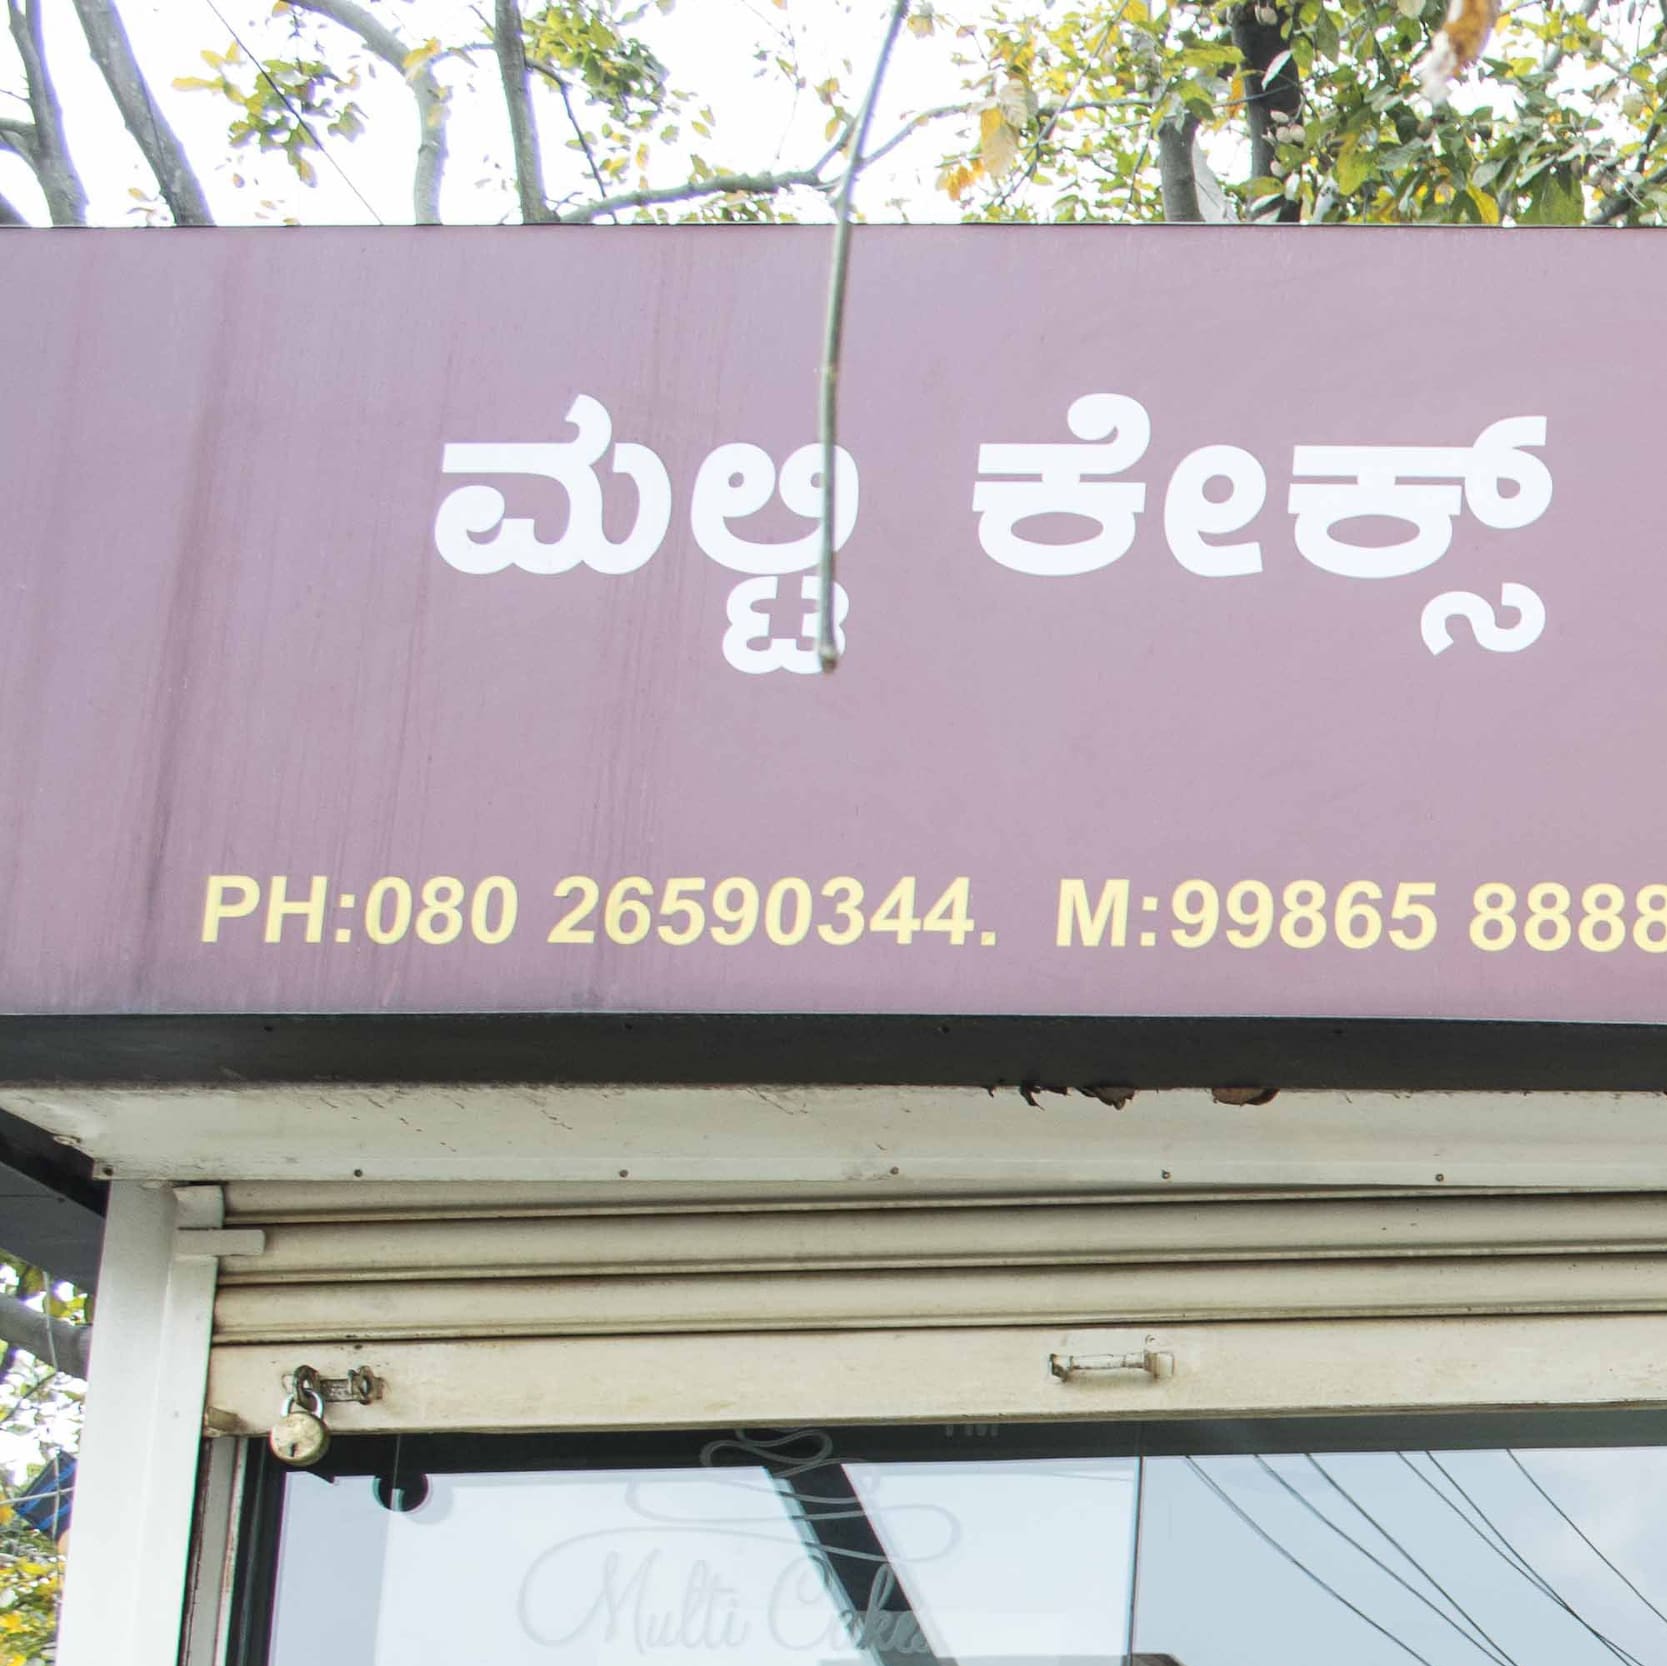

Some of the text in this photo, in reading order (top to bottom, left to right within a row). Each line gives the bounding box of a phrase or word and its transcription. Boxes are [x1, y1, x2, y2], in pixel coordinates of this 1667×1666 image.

[971, 392, 1553, 656] ಕೇಕ್ಸ್
[203, 876, 515, 944] PH:080
[549, 876, 993, 945] 26590344.
[1058, 879, 1435, 949] M:99865
[518, 1548, 751, 1656] Multi
